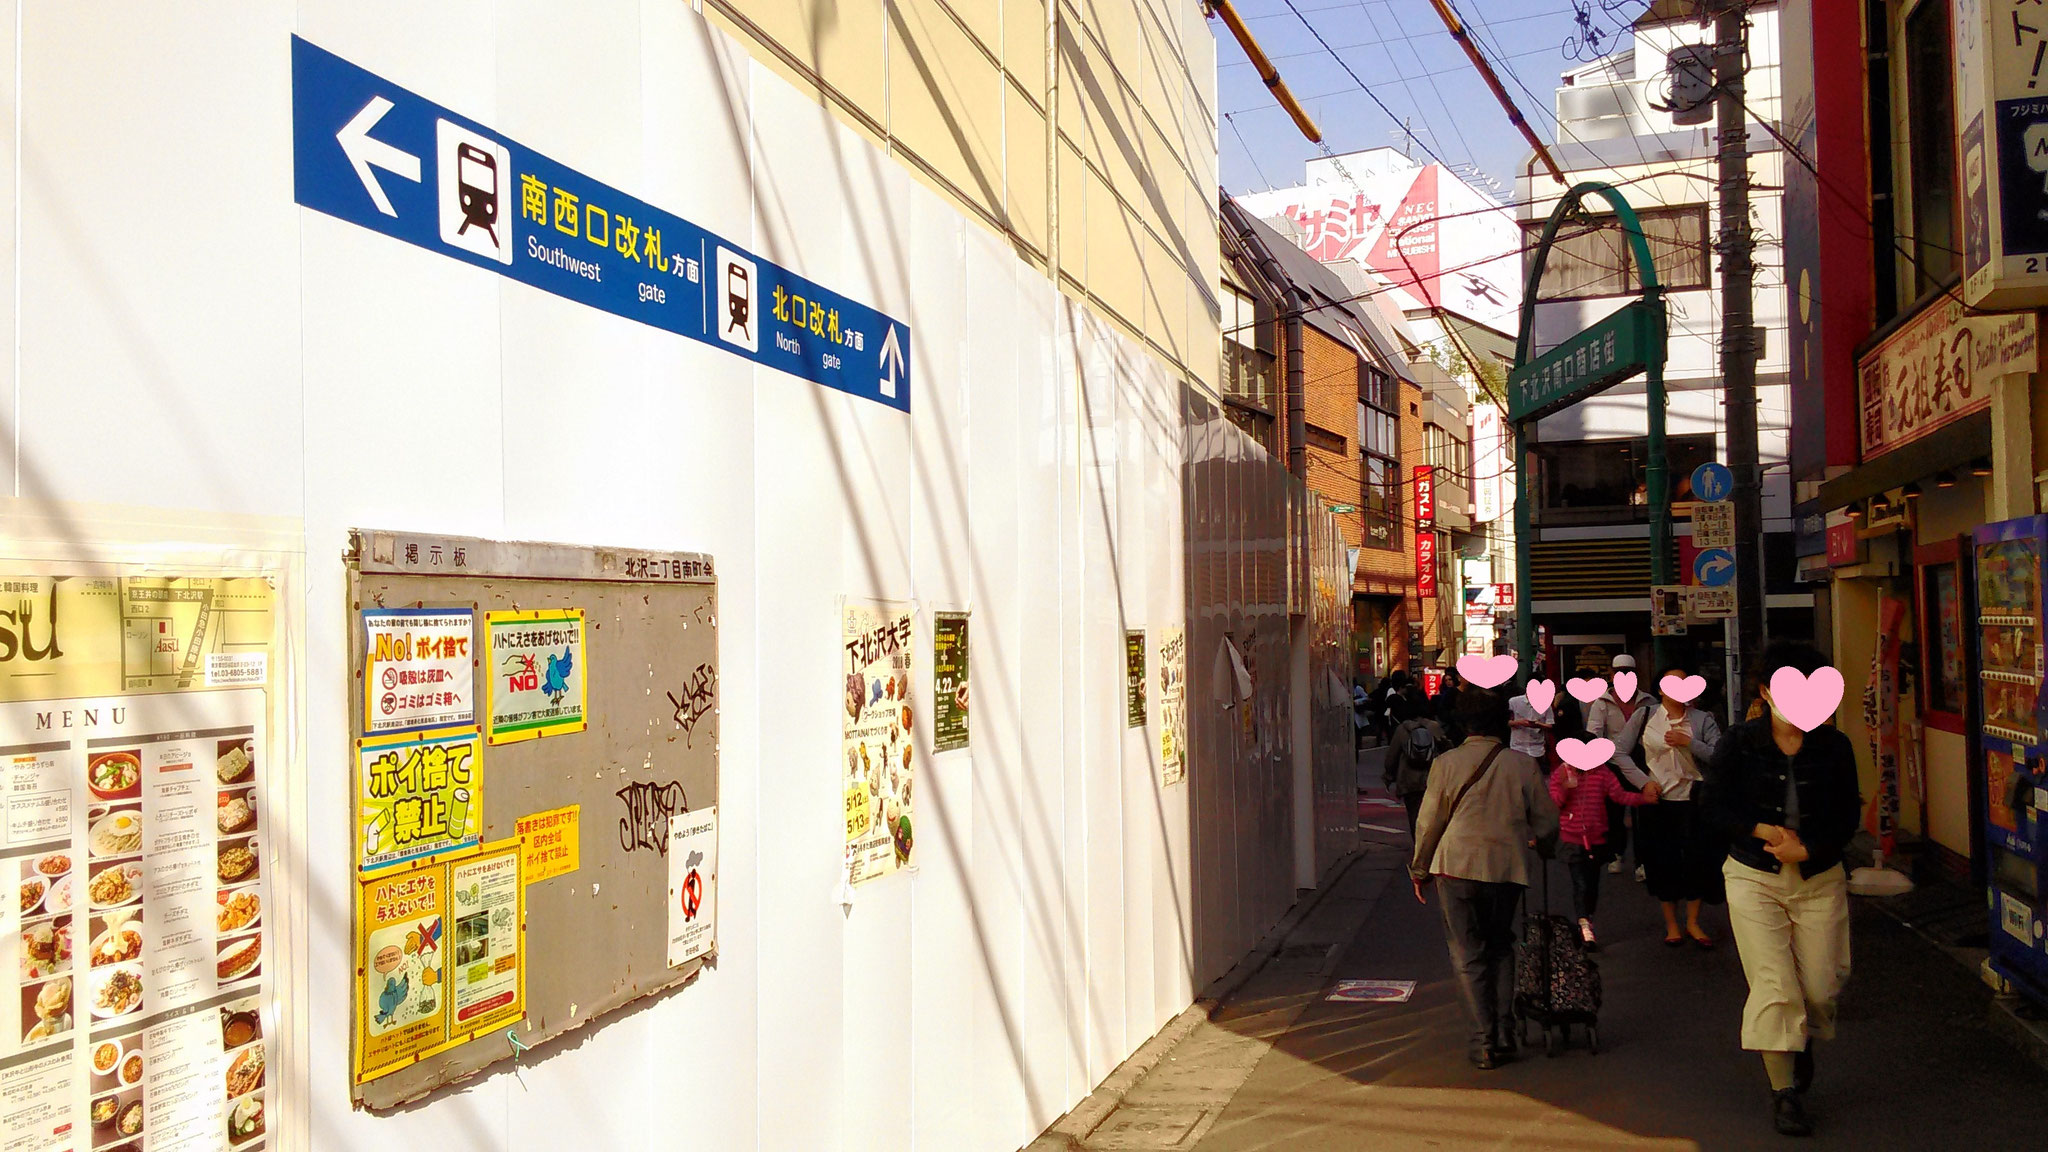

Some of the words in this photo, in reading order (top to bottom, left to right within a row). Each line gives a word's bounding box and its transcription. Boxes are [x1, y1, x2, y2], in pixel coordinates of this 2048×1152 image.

[2012, 0, 2047, 90] ト!
[1405, 201, 1435, 214] NEC
[1386, 244, 1436, 258] MISUBISHI
[528, 236, 601, 283] Southwest
[638, 281, 666, 306] gate
[776, 331, 801, 356] North
[822, 351, 842, 372] gate
[1519, 329, 1615, 408] 下北沢南口商店街
[1896, 326, 1973, 433] 元祖寿司
[1419, 481, 1430, 516] ガスト
[405, 543, 467, 567] 掲示板
[625, 560, 714, 579] 北沢二丁目南町会
[1420, 539, 1431, 584] カラオケ
[375, 632, 412, 662] No!
[416, 635, 468, 660] ポイ捨て
[493, 628, 579, 649] ハトにえさをあげないで!!
[846, 613, 911, 674] 下北沢大学
[399, 669, 453, 685] 吸殻は灰皿へ
[510, 674, 538, 693] NO
[398, 691, 461, 709] ゴミはゴミ箱へ
[369, 743, 473, 798] ポイ捨て
[394, 792, 448, 845] 禁止
[517, 810, 578, 836] 落書きは犯罪です!!
[534, 829, 562, 848] 区内全域
[457, 858, 515, 879] ハトにエサをあげないで!!
[527, 844, 568, 867] ポイ捨て禁止
[376, 874, 435, 903] ハトにエサを
[376, 893, 435, 923] 与えないで!!
